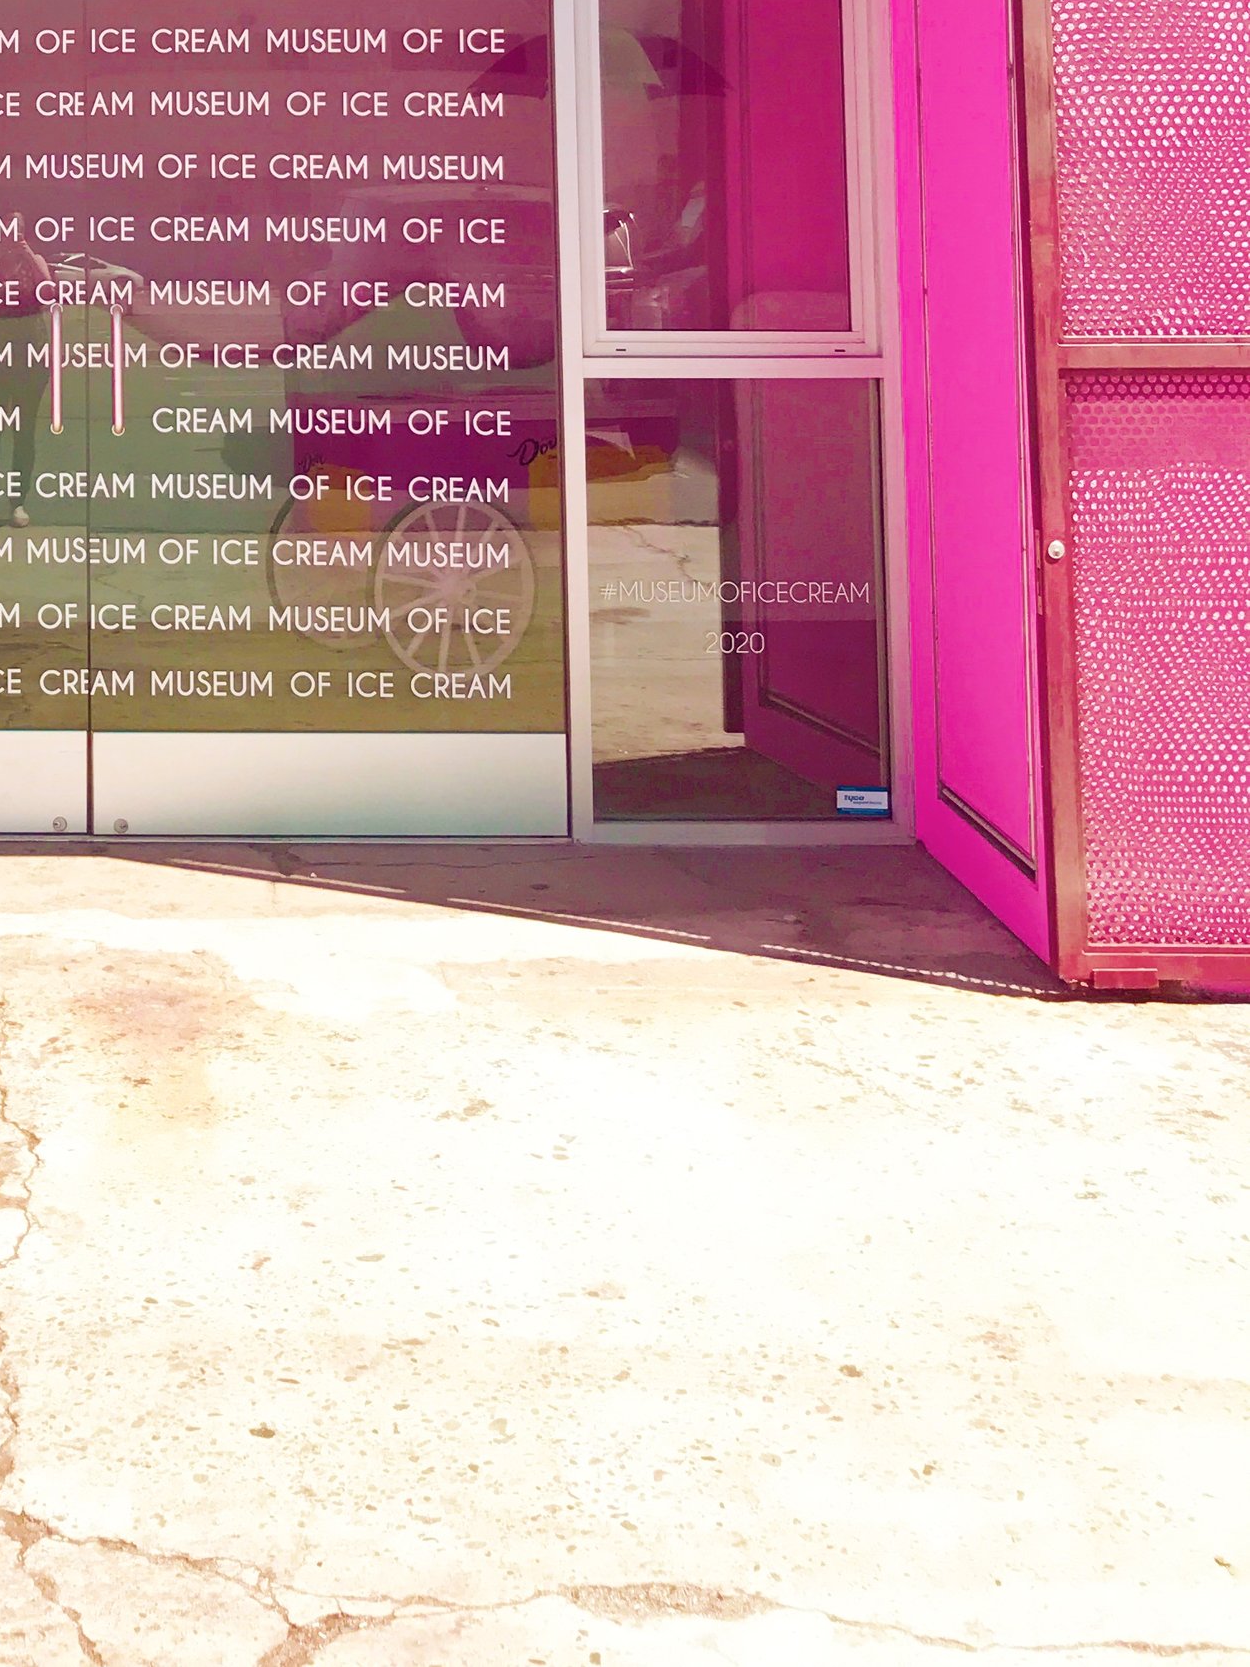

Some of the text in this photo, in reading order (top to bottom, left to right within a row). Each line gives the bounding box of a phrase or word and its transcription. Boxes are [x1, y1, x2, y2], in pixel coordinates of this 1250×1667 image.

[35, 29, 75, 54] OF
[91, 28, 136, 53] ICE
[151, 28, 250, 54] CREAM
[267, 28, 386, 53] MUSEUM
[402, 28, 443, 53] OF
[459, 28, 505, 53] ICE
[35, 91, 133, 117] CREAM
[151, 91, 270, 116] MUSEUM
[286, 91, 327, 116] OF
[342, 91, 388, 117] ICE
[404, 91, 504, 117] CREAM
[25, 153, 144, 179] MUSEUM
[157, 153, 198, 179] OF
[211, 153, 256, 179] ICE
[269, 154, 368, 180] CREAM
[383, 154, 504, 181] MUSEUM
[34, 216, 75, 242] OF
[89, 216, 135, 242] ICE
[150, 216, 249, 242] CREAM
[266, 216, 386, 243] MUSEUM
[402, 217, 443, 243] OF
[459, 218, 505, 244] ICE
[35, 279, 133, 306] CREAM
[150, 280, 270, 306] MUSEUM
[286, 280, 327, 306] OF
[343, 281, 389, 307] ICE
[404, 282, 505, 308] CREAM
[159, 342, 200, 369] OF
[213, 343, 260, 369] ICE
[272, 343, 373, 370] CREAM
[387, 344, 509, 371] MUSEUM
[152, 407, 252, 434] CREAM
[269, 408, 391, 435] MUSEUM
[408, 409, 449, 435] OF
[465, 410, 511, 436] ICE
[35, 472, 135, 499] CREAM
[151, 473, 272, 500] MUSEUM
[289, 474, 330, 501] OF
[346, 475, 392, 502] ICE
[408, 476, 509, 503] CREAM
[26, 537, 146, 564] MUSEUM
[158, 538, 199, 565] OF
[212, 539, 259, 566] ICE
[272, 539, 372, 567] CREAM
[387, 541, 509, 569] MUSEUM
[599, 580, 871, 605] #MUSEUMOFICECREAM
[37, 603, 78, 630] OF
[90, 604, 137, 630] ICE
[150, 604, 251, 631] CREAM
[269, 605, 390, 633] MUSEUM
[407, 607, 448, 634] OF
[464, 608, 511, 635] ICE
[705, 630, 766, 655] 2020
[39, 668, 134, 696] CREAM
[151, 670, 273, 697] MUSEUM
[290, 671, 331, 697] OF
[348, 672, 394, 698] ICE
[410, 672, 511, 699] CREAM
